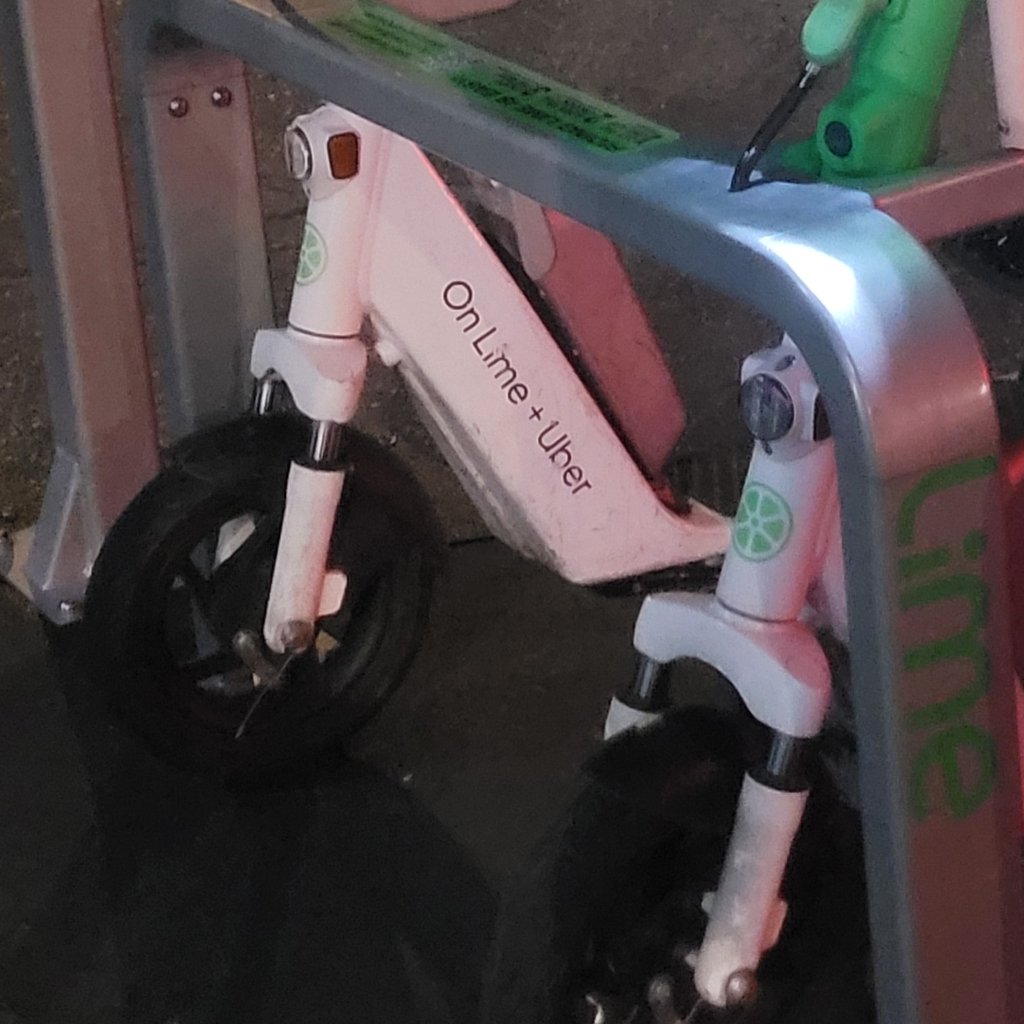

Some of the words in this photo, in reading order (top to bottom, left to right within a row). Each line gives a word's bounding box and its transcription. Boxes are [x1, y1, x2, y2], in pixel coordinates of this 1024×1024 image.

[443, 280, 480, 333] On
[472, 327, 528, 405] Lime
[528, 406, 544, 421] +
[538, 421, 592, 495] Uber
[897, 454, 998, 821] Lime
